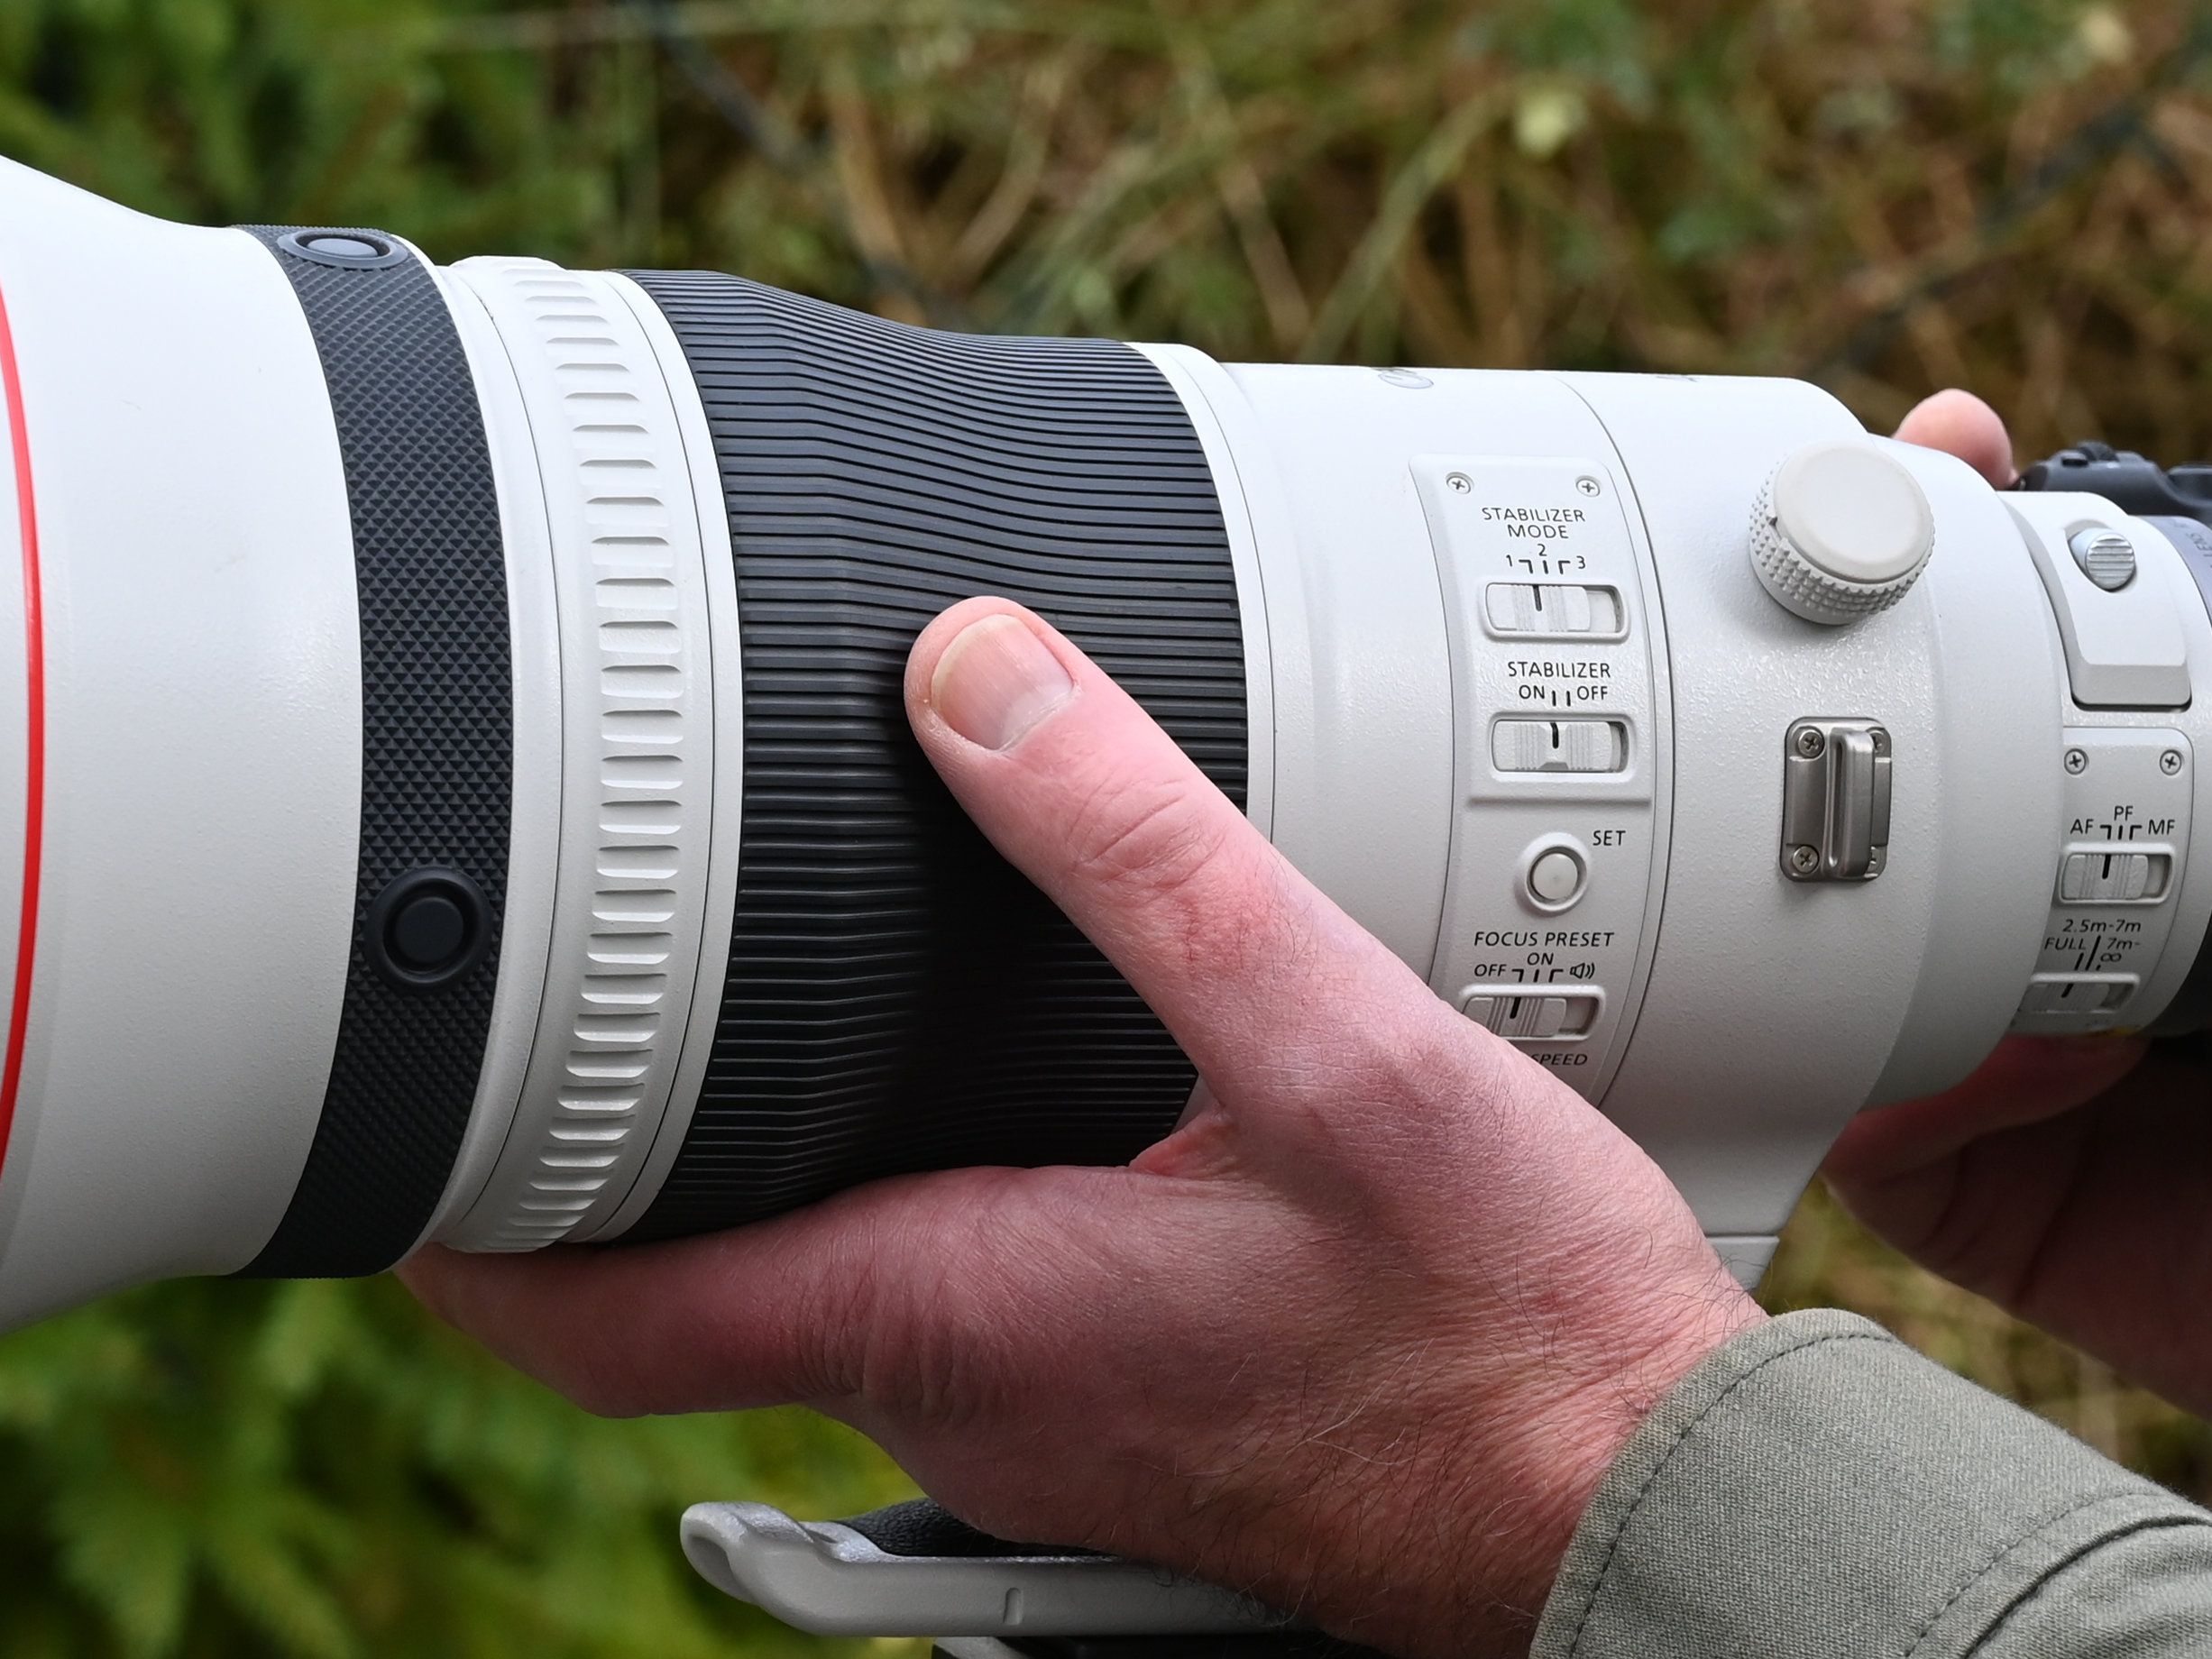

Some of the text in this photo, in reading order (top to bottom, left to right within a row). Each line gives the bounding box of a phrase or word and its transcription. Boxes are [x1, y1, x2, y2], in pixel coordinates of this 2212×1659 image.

[1482, 507, 1586, 522] STABILIZER
[1507, 524, 1569, 539] MODE
[1537, 544, 1547, 556] 2
[1506, 555, 1513, 567] 1
[1577, 555, 1586, 569] 3
[1508, 661, 1611, 678] STABILIZER
[1519, 685, 1546, 700] ON
[1577, 686, 1608, 700] OFF
[2114, 805, 2134, 821] PF
[2070, 819, 2094, 834] AF
[2148, 820, 2175, 835] MF
[1592, 830, 1626, 846] SET
[1473, 931, 1614, 947] FOCUS PRESET
[2044, 937, 2087, 950] FULL
[1527, 952, 1554, 966] ON
[1473, 964, 1507, 976] OFF
